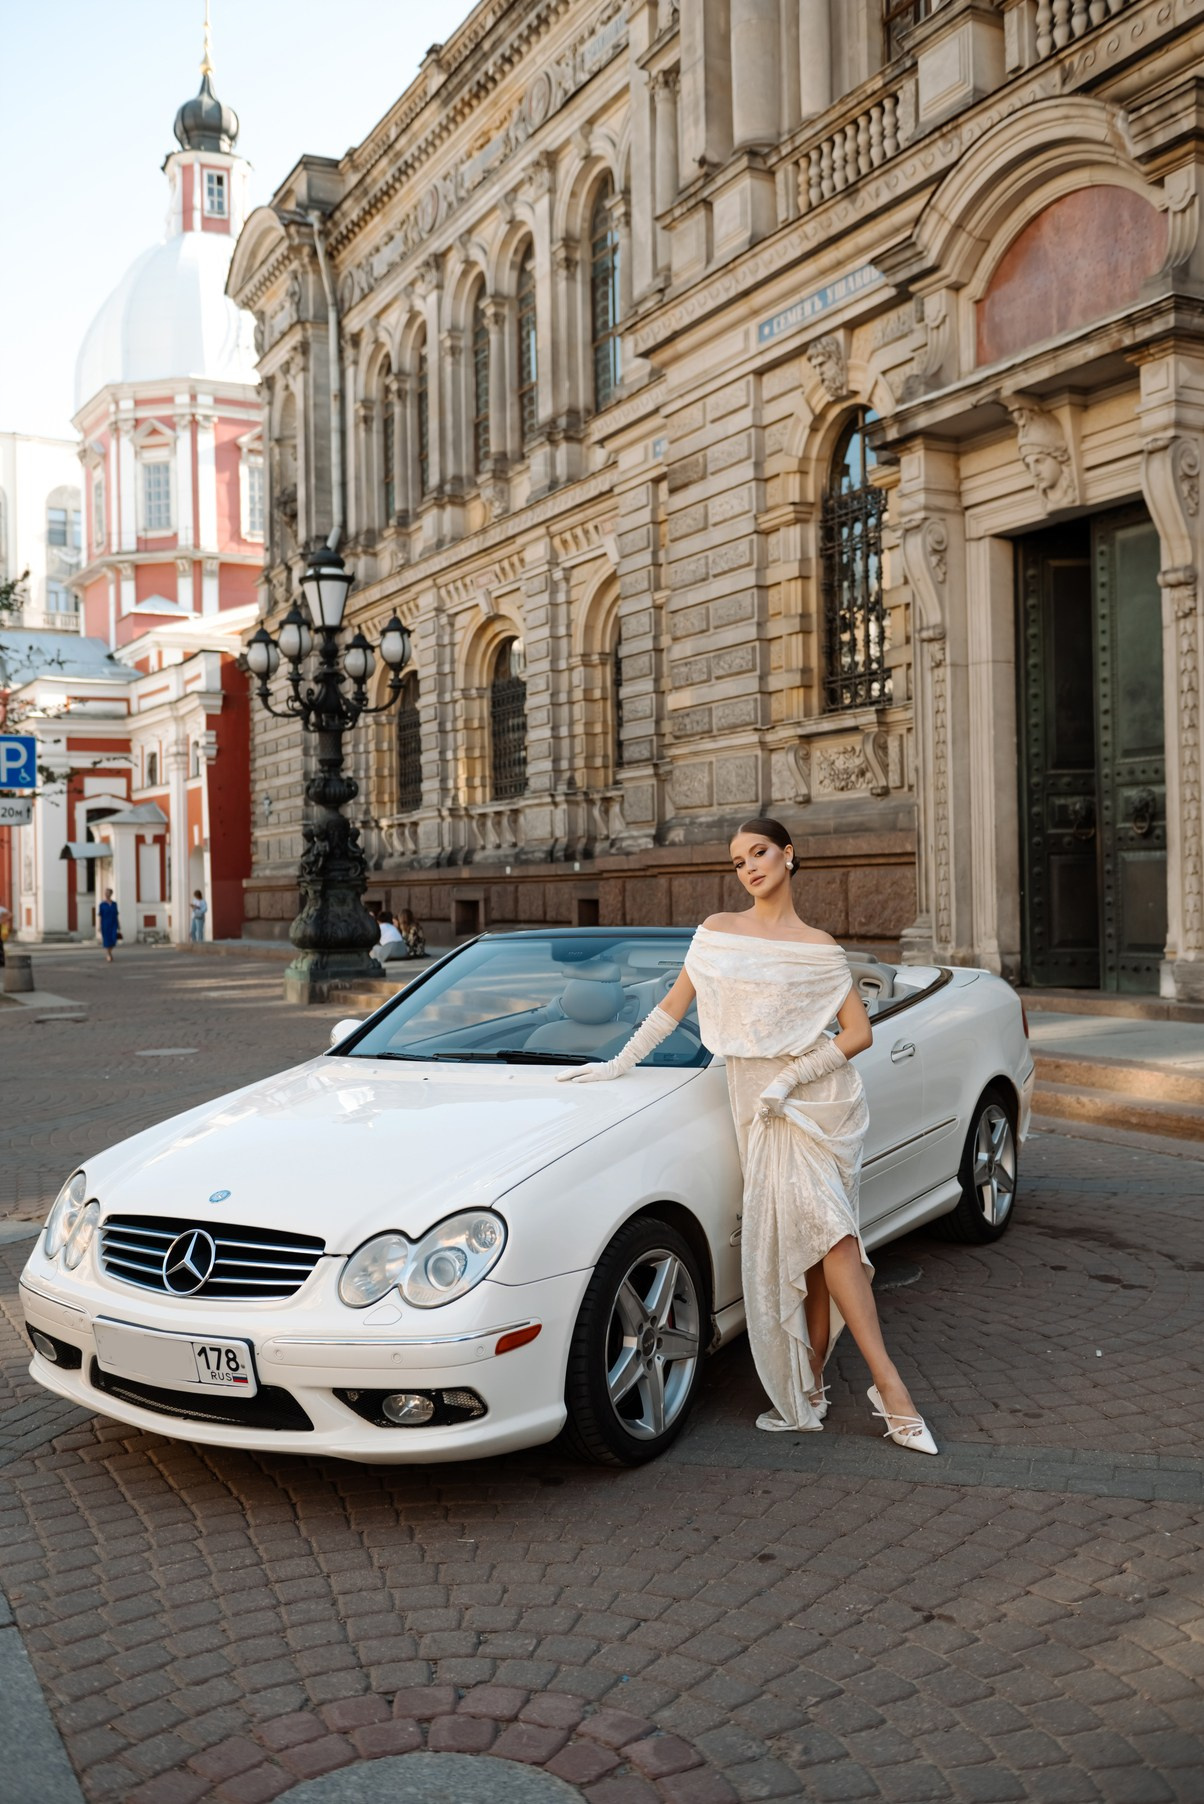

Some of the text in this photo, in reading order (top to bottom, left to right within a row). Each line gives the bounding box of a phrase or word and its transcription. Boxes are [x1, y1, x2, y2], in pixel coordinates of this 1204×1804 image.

[0, 741, 28, 783] P
[197, 1346, 240, 1372] 178
[210, 1371, 232, 1382] RUS
